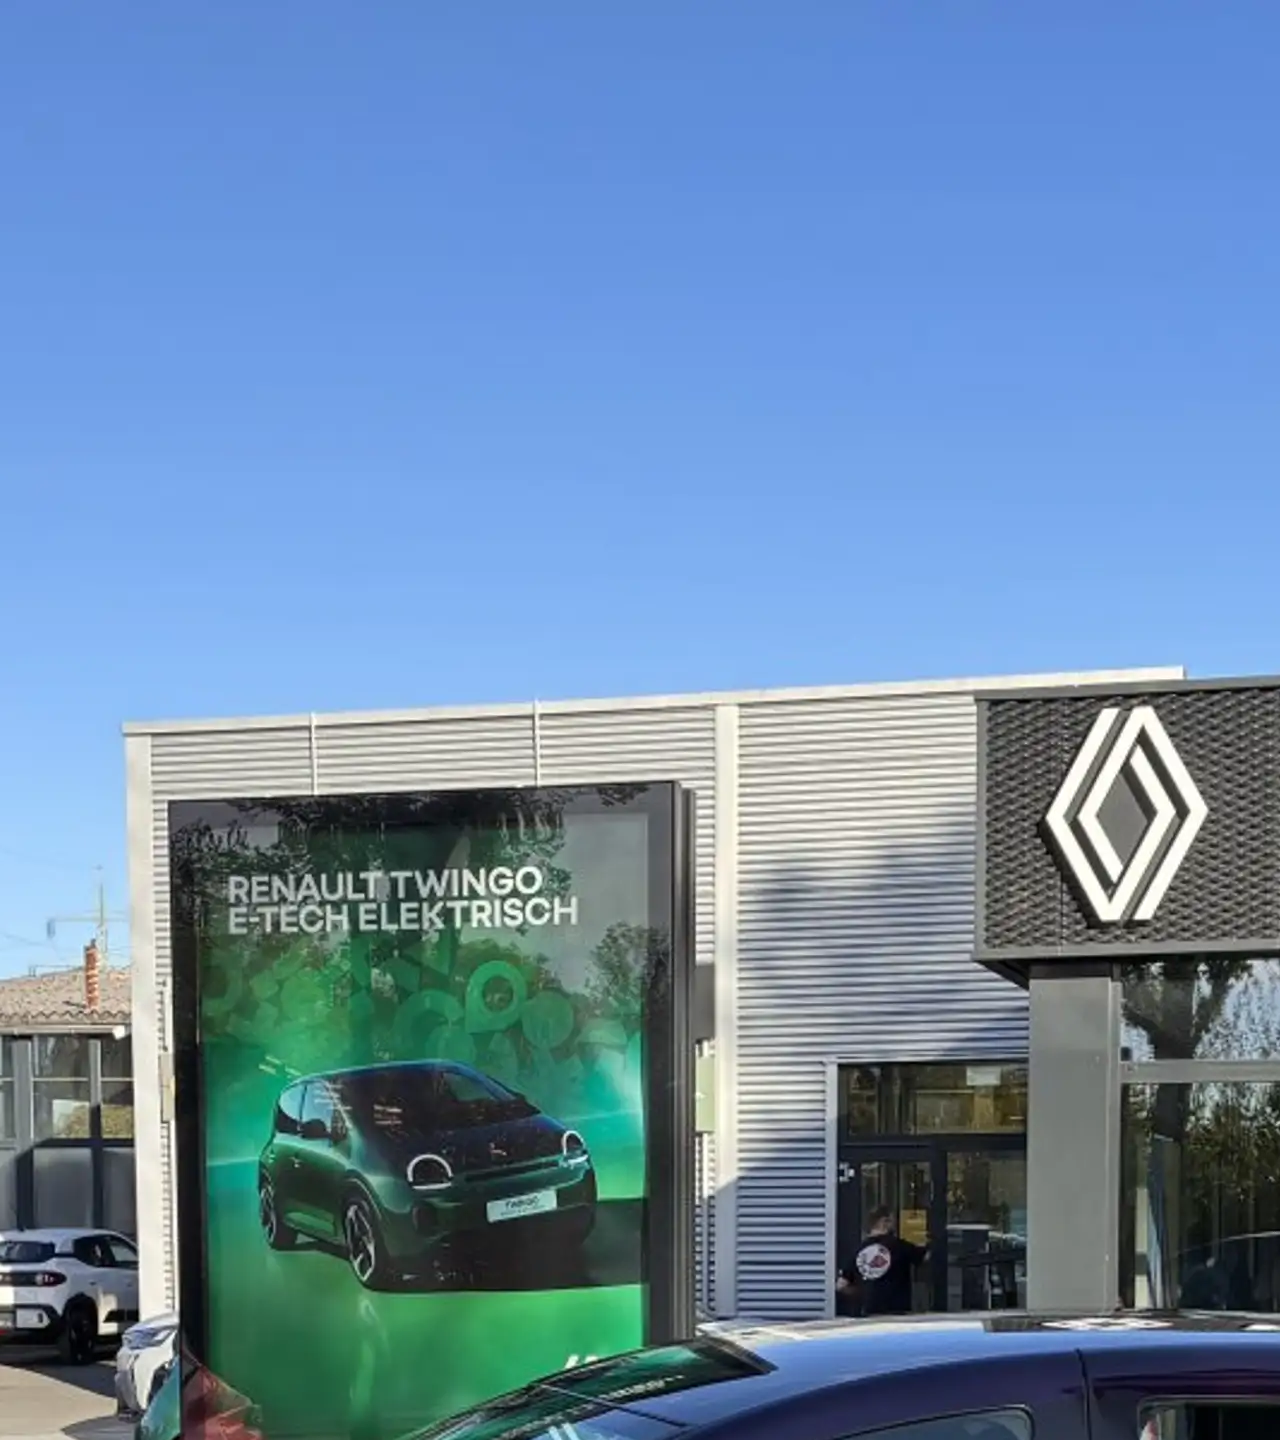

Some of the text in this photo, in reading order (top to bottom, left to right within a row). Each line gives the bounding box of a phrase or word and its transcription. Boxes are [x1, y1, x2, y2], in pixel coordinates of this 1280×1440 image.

[228, 866, 544, 904] RENAULT TWINGO
[228, 897, 580, 934] E-TECH ELEKTRISCH
